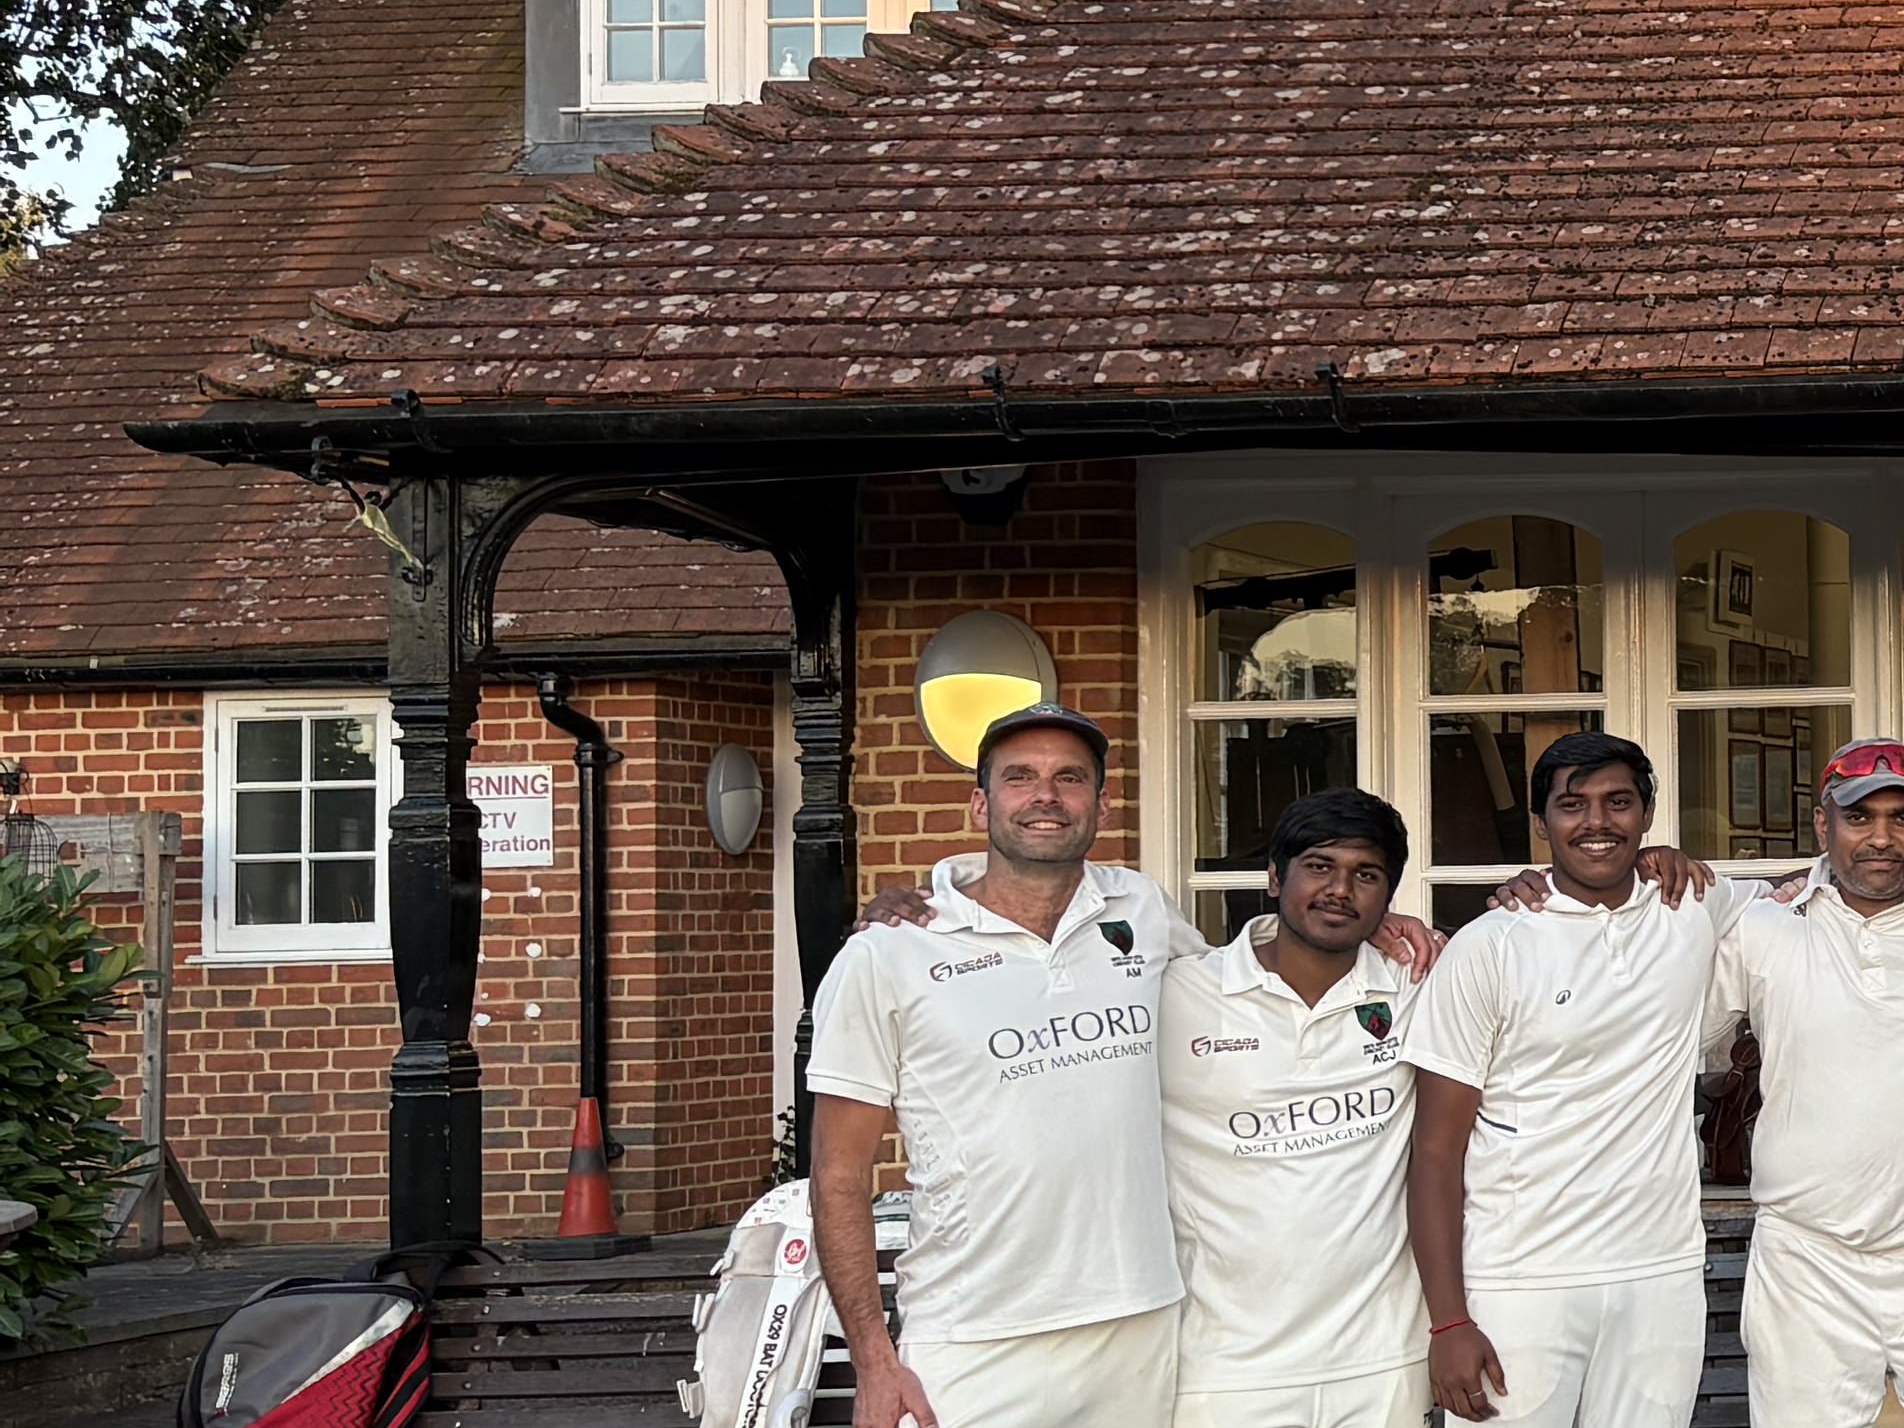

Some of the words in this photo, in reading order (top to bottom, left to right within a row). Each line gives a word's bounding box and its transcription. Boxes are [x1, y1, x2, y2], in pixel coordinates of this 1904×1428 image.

[467, 774, 549, 797] RNING
[480, 835, 550, 852] eration
[999, 1058, 1046, 1084] ASSET
[1051, 1041, 1153, 1069] MANAGEMENT
[1372, 1051, 1396, 1065] ACJ
[1233, 1142, 1279, 1157] ASSET
[767, 1304, 788, 1340] OX29
[759, 1343, 778, 1368] BAT
